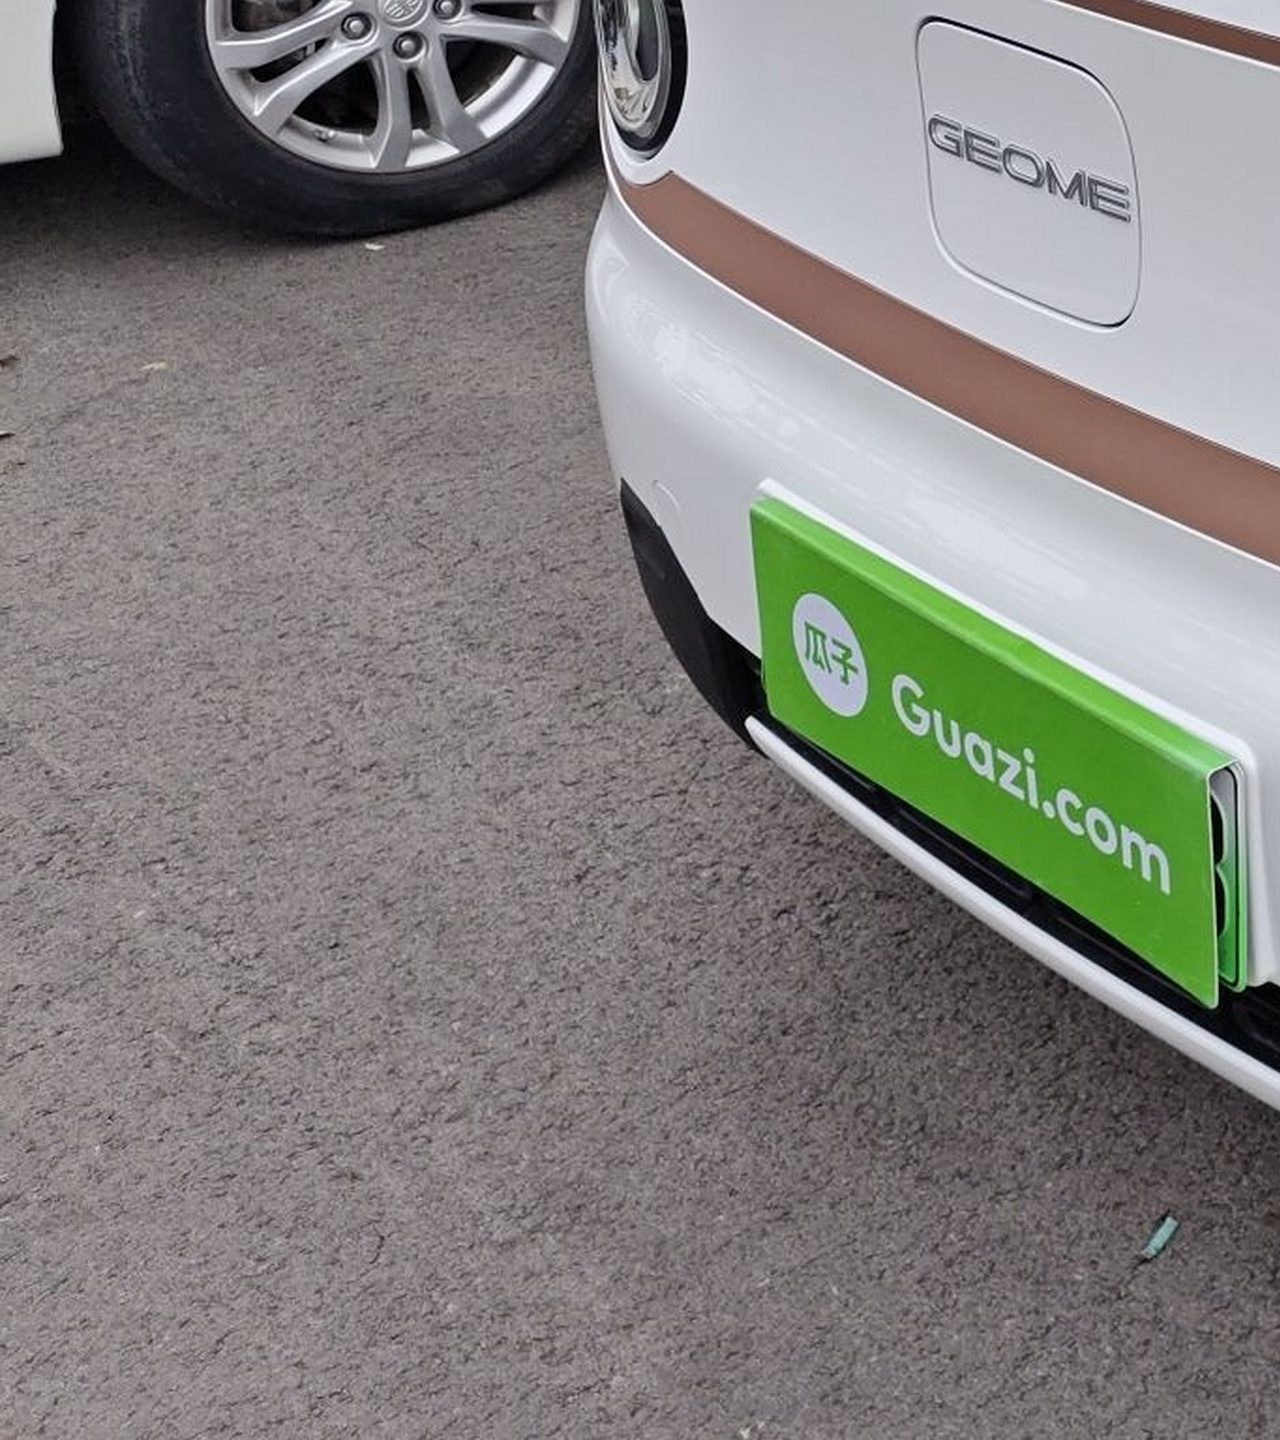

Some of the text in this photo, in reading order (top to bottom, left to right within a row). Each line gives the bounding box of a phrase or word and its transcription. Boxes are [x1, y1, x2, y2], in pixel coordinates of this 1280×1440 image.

[927, 113, 1131, 223] GEOME
[803, 620, 859, 685] 瓜子
[890, 673, 1171, 896] Guazi.com
